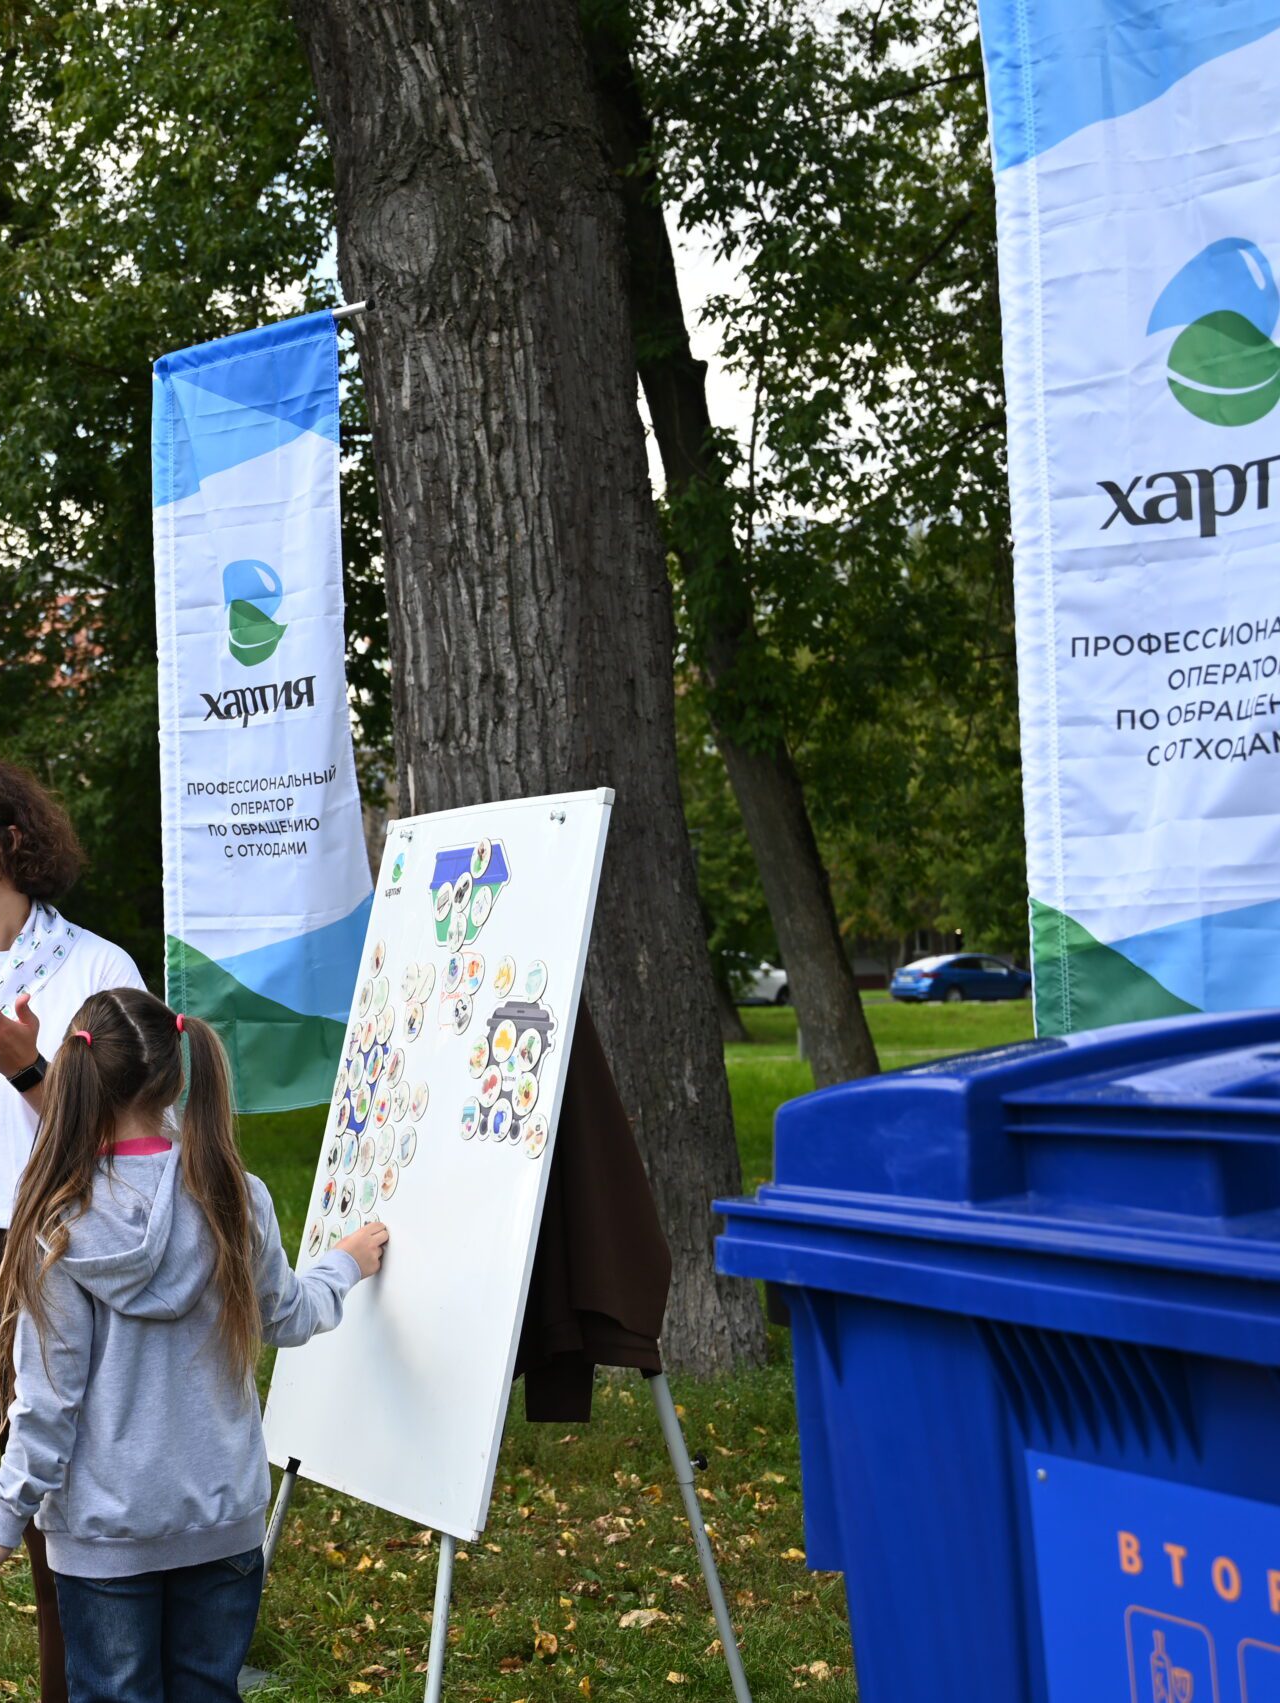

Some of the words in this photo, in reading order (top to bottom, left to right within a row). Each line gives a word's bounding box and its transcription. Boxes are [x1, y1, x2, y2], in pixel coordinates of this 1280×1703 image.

[1095, 454, 1280, 538] харт
[1071, 616, 1280, 659] ПРОФЕССИОНА
[1167, 655, 1280, 691] ОПЕРАТО
[200, 675, 317, 728] хартия
[1116, 708, 1160, 731] ПО
[1167, 693, 1280, 727] ОБРАЩЕН
[1146, 744, 1161, 767] С
[187, 764, 337, 796] ПРОФЕССИОНАЛЬНЫЙ
[231, 797, 294, 816] ОПЕРАТОР
[208, 824, 227, 837] ПО
[231, 817, 320, 836] ОБРАЩЕНИЮ
[224, 845, 234, 858] С
[237, 841, 308, 858] ОТХОДАМИ
[1117, 1530, 1280, 1615] ВТОР
